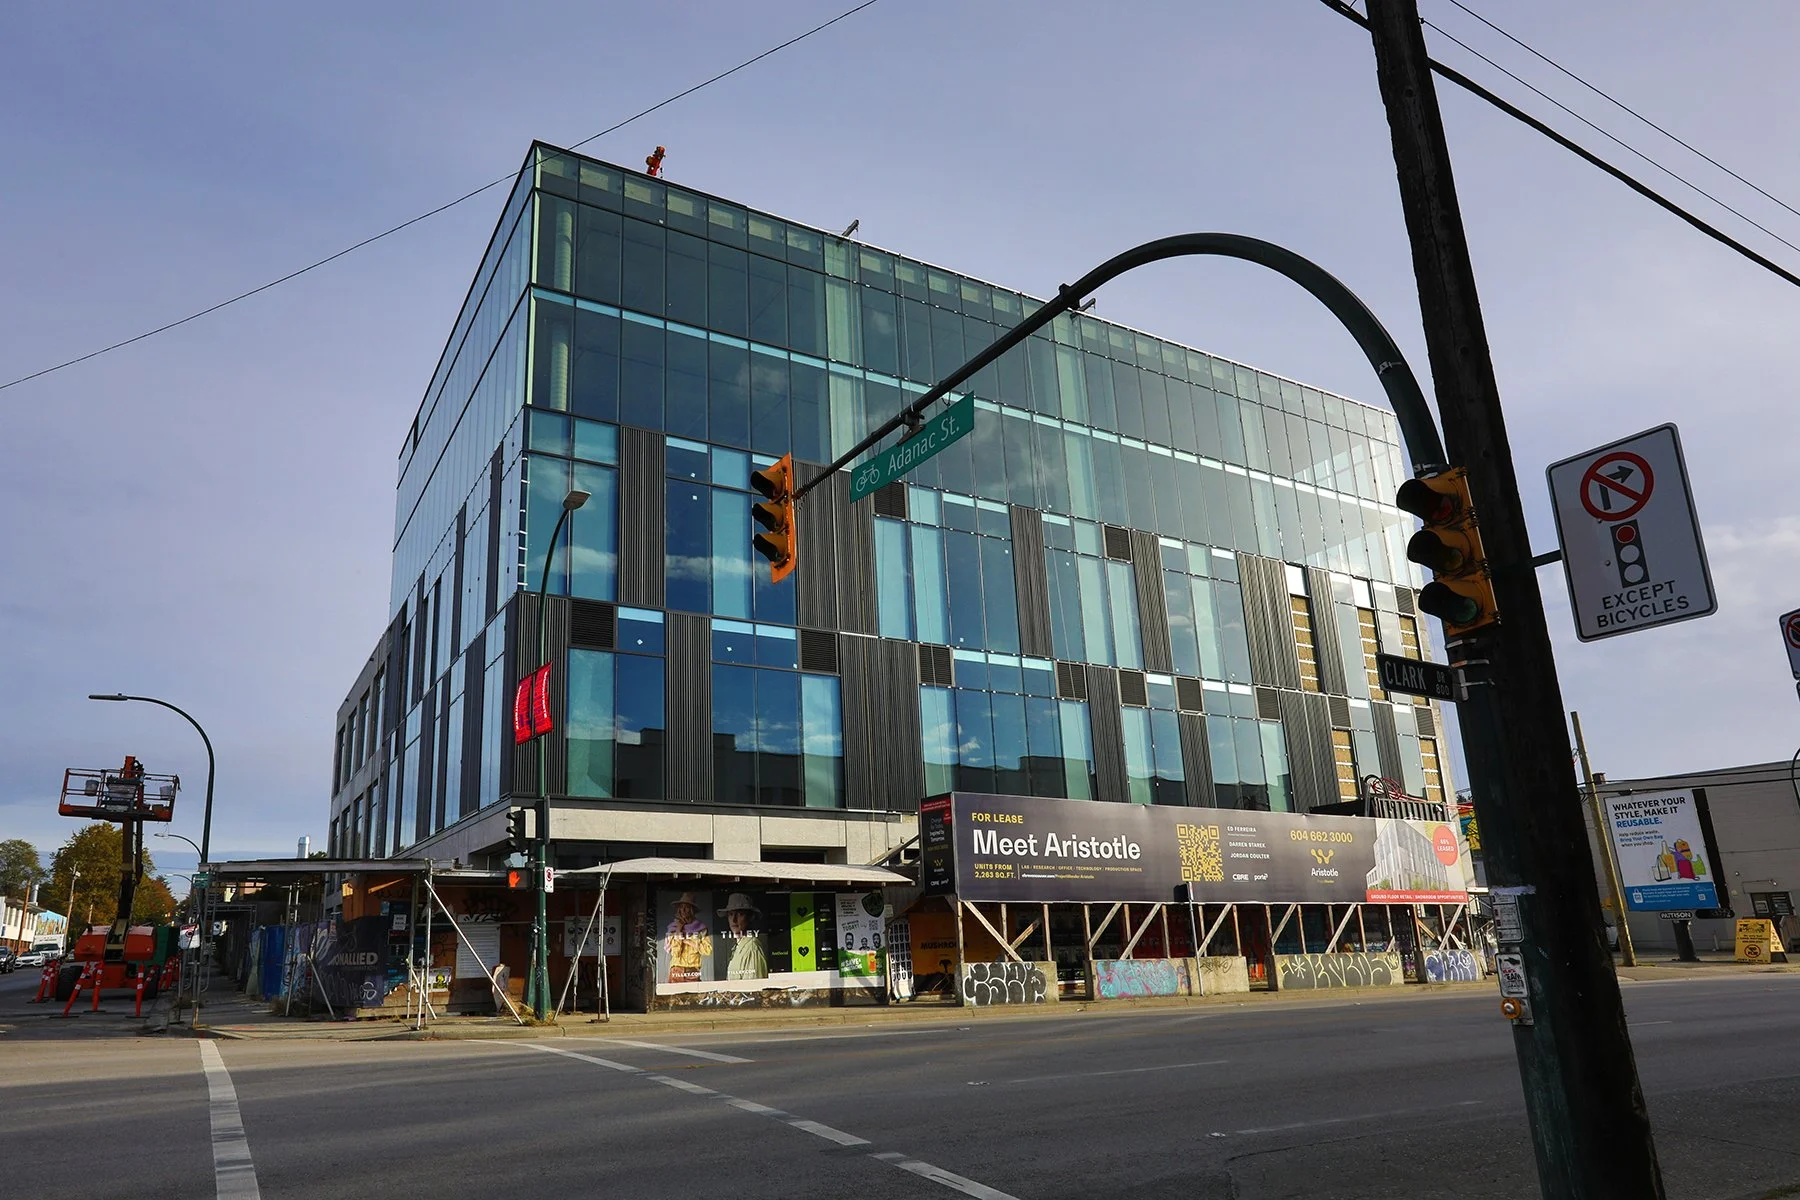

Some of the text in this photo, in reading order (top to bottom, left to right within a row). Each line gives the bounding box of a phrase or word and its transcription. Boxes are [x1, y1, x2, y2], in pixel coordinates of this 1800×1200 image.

[888, 415, 960, 475] Adanac St.
[1602, 580, 1676, 610] EXCEPT
[1596, 595, 1690, 628] BICYCLES
[1384, 660, 1426, 690] CLARK
[1612, 796, 1686, 811] WHATEVER YOUR
[971, 812, 1024, 824] FOR LEASE
[1614, 806, 1679, 820] STYLE, MAKE IT
[1616, 817, 1662, 828] REUSABLE.
[1290, 830, 1353, 843] 604 662 3000
[972, 829, 1039, 857] Meet
[1044, 832, 1142, 860] Aristotle
[1311, 867, 1339, 877] Aristotle
[666, 931, 706, 941] TILLEY
[720, 930, 760, 939] TILLEY
